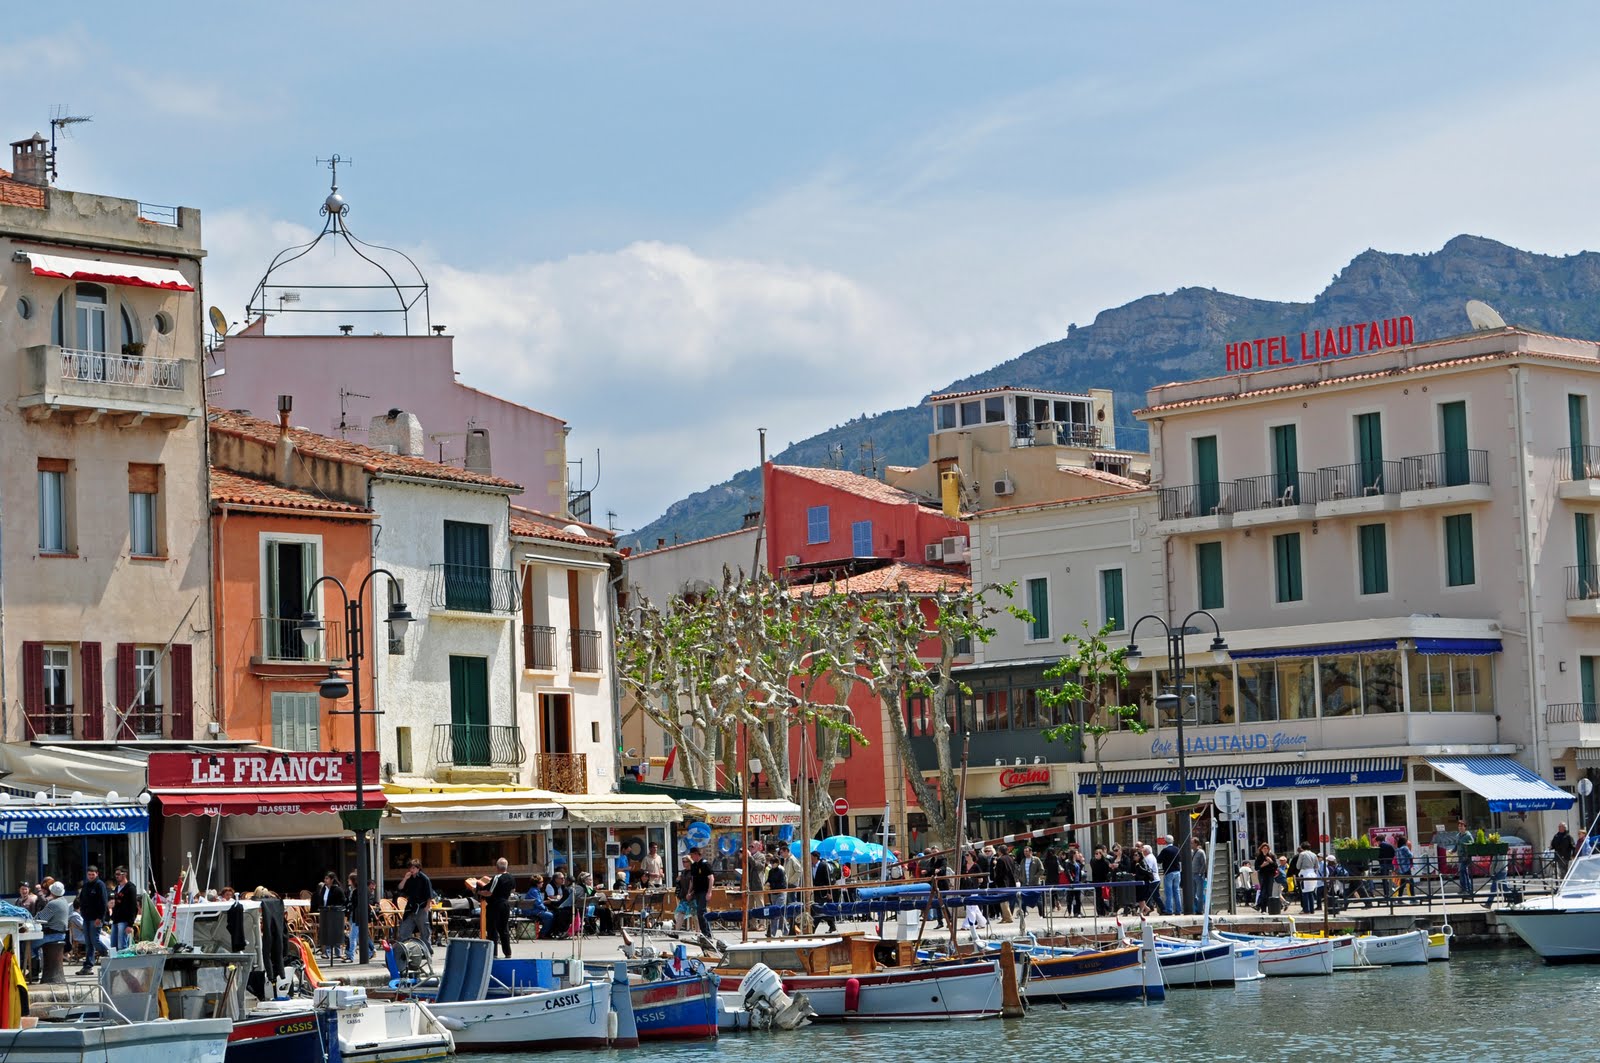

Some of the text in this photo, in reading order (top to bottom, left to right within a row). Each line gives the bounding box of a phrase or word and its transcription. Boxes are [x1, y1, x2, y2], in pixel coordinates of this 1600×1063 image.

[1225, 315, 1414, 371] HOTEL LIAUTAUD
[1272, 732, 1308, 750] Glacier
[191, 756, 343, 783] LE FRANCE
[999, 768, 1050, 789] Casino
[1294, 775, 1321, 786] Glacier
[257, 805, 300, 813] BRASSERIE
[749, 814, 778, 825] DELPHIN
[46, 821, 80, 832] GLACIER
[85, 821, 126, 831] COCKTAILS
[545, 994, 581, 1010] CASSIS
[636, 1011, 666, 1023] ASSIS
[280, 1021, 313, 1034] CASSIS
